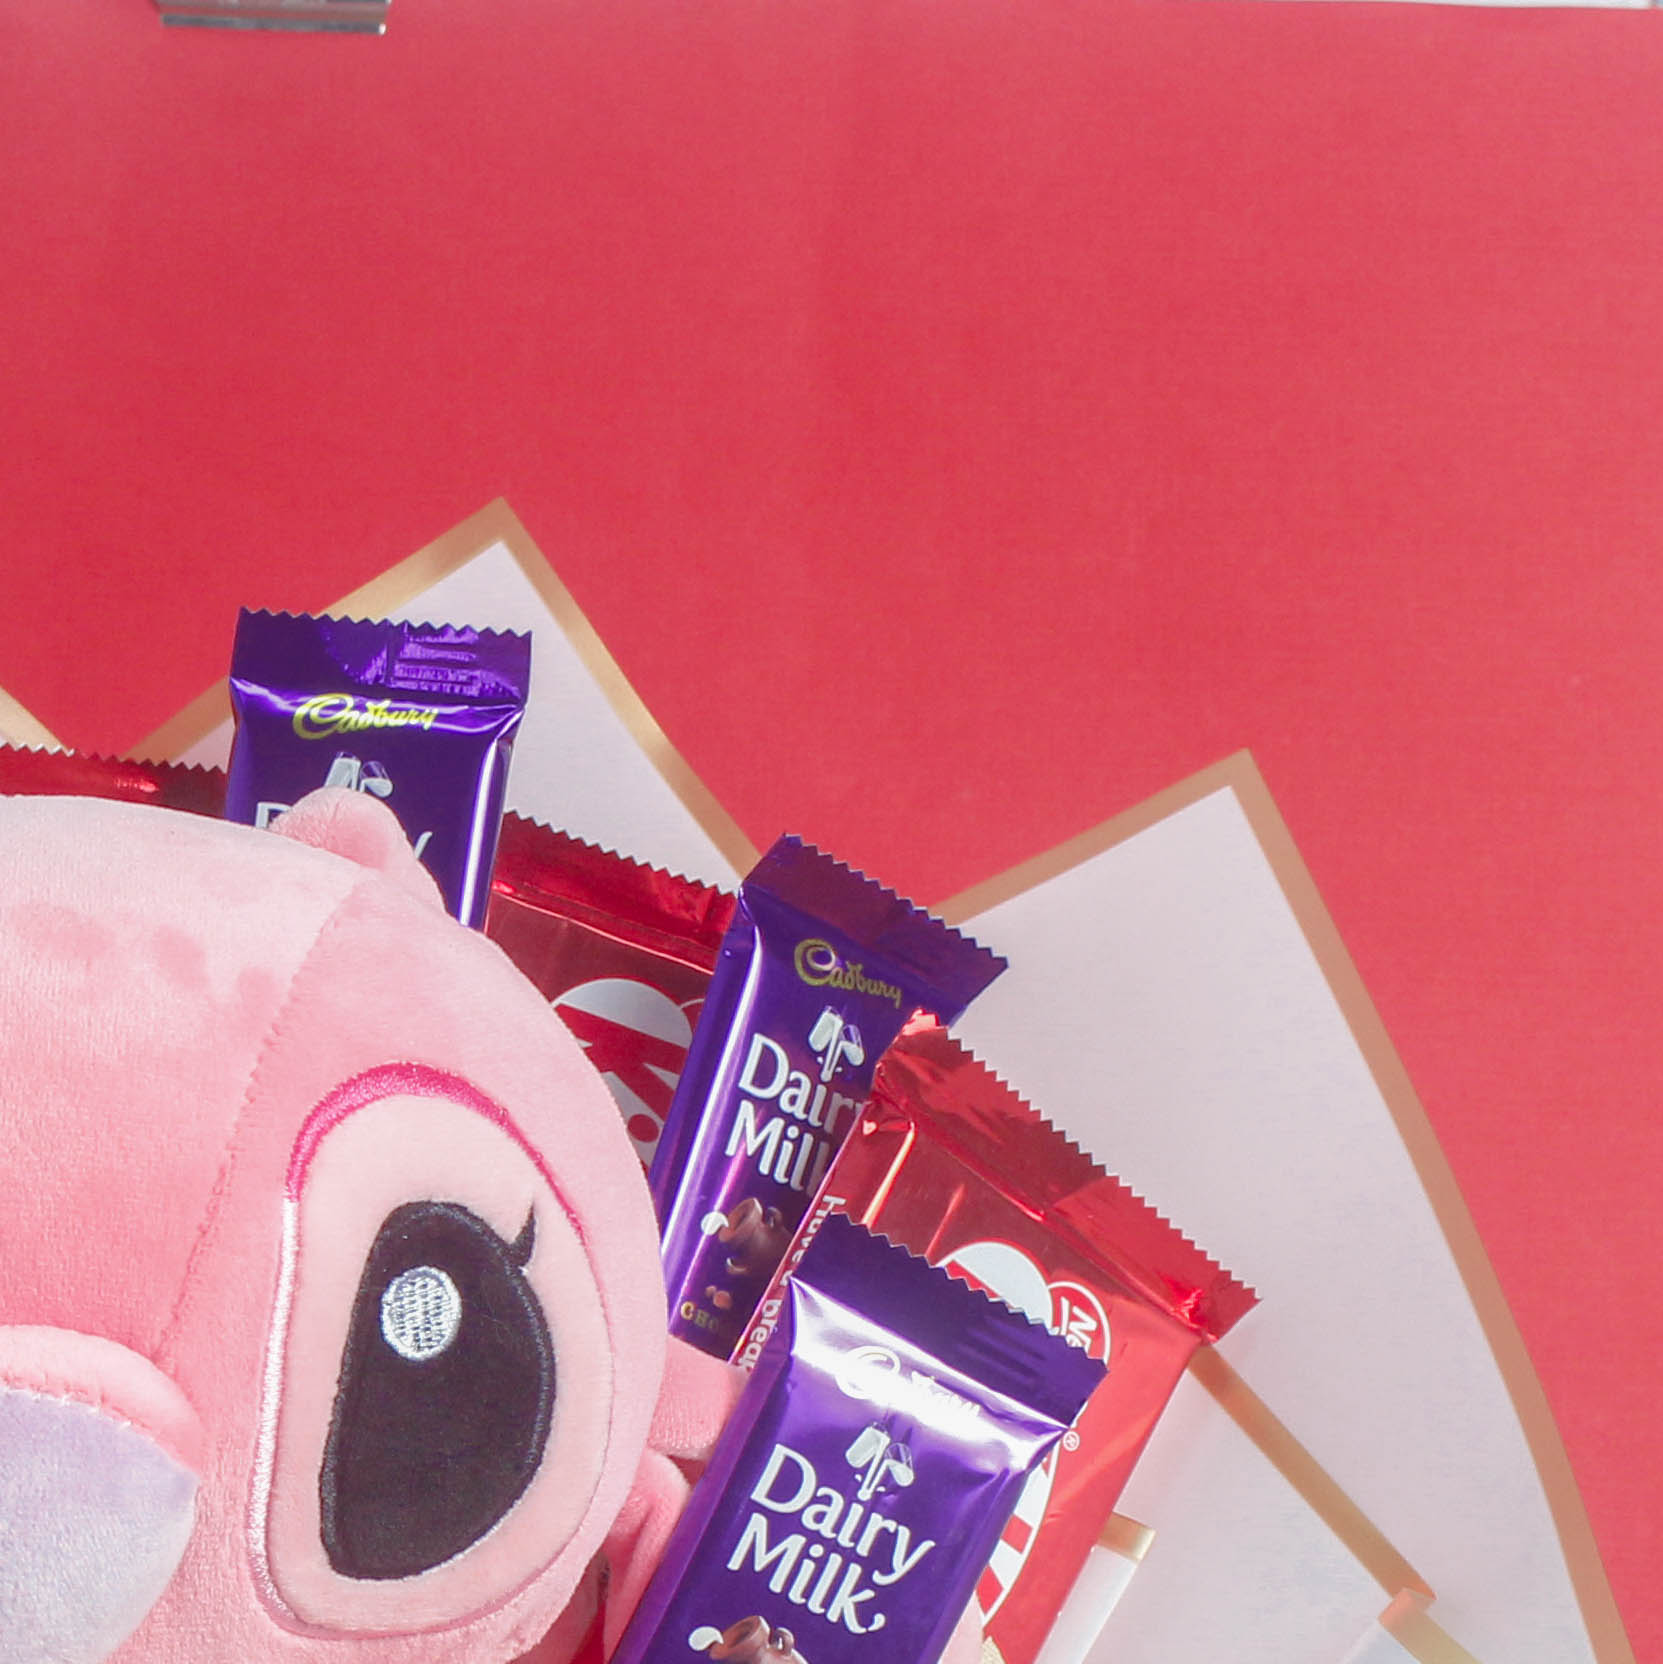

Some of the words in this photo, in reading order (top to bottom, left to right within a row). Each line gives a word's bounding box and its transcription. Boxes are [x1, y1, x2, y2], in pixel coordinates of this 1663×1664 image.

[292, 693, 439, 740] Cadbury
[794, 938, 902, 1009] Cadbury
[738, 1032, 869, 1134] Dair
[750, 1442, 936, 1586] Dairy
[726, 1511, 885, 1634] Milk
